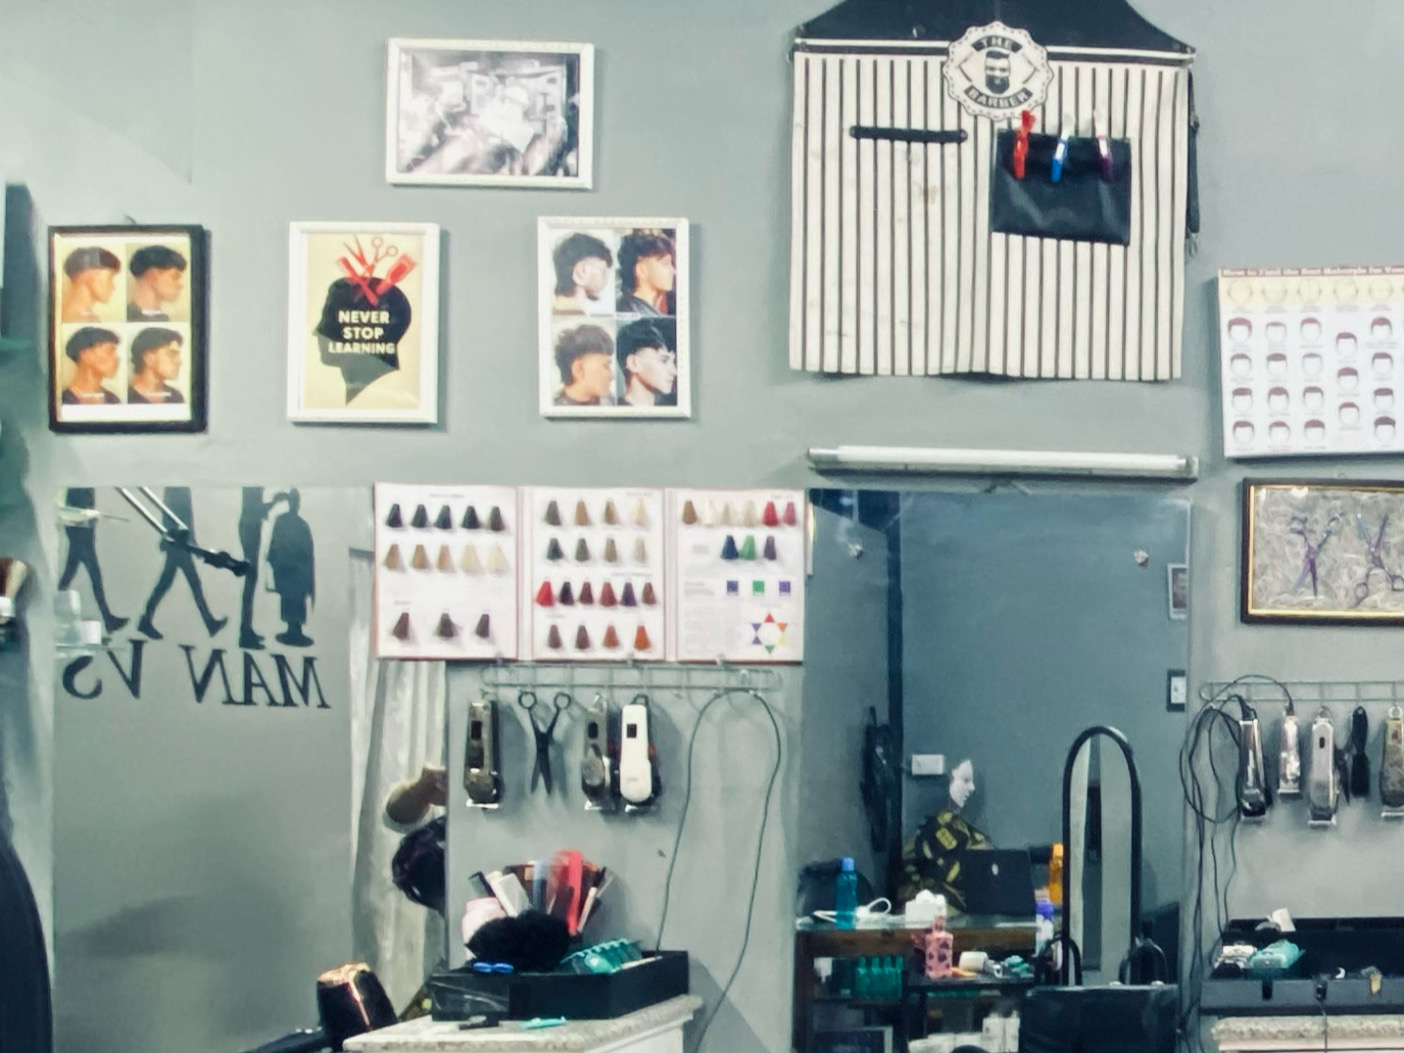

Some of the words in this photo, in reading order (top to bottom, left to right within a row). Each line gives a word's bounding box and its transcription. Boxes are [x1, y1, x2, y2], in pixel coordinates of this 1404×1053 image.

[982, 36, 1013, 50] THE
[967, 89, 1030, 108] BARBER
[338, 309, 390, 324] NEVER
[342, 326, 385, 340] STOP
[327, 341, 397, 354] LEARNING
